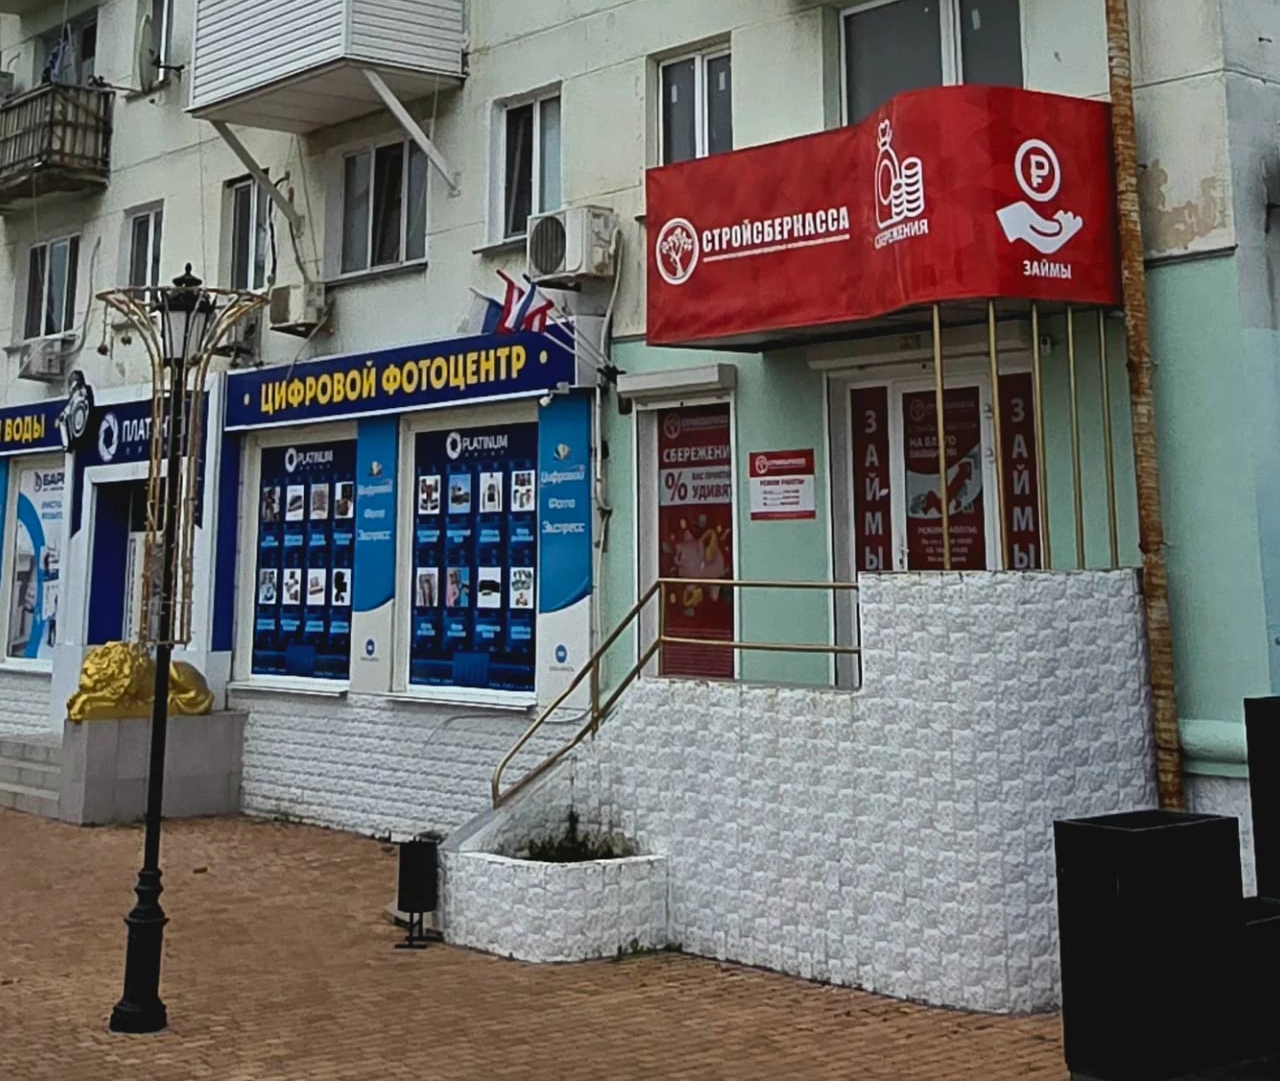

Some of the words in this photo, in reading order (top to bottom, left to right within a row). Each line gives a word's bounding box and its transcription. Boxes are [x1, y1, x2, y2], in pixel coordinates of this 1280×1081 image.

[702, 206, 850, 253] СТРОЙСБЕРКАССА
[1023, 259, 1072, 279] ЗАЙМЫ
[261, 360, 376, 415] ЦИФРОВОЙ
[381, 345, 526, 394] ФОТОЦЕНТР
[4, 415, 46, 444] ВОДЫ
[462, 434, 509, 451] PLATINUM
[297, 449, 333, 464] PLATINUM
